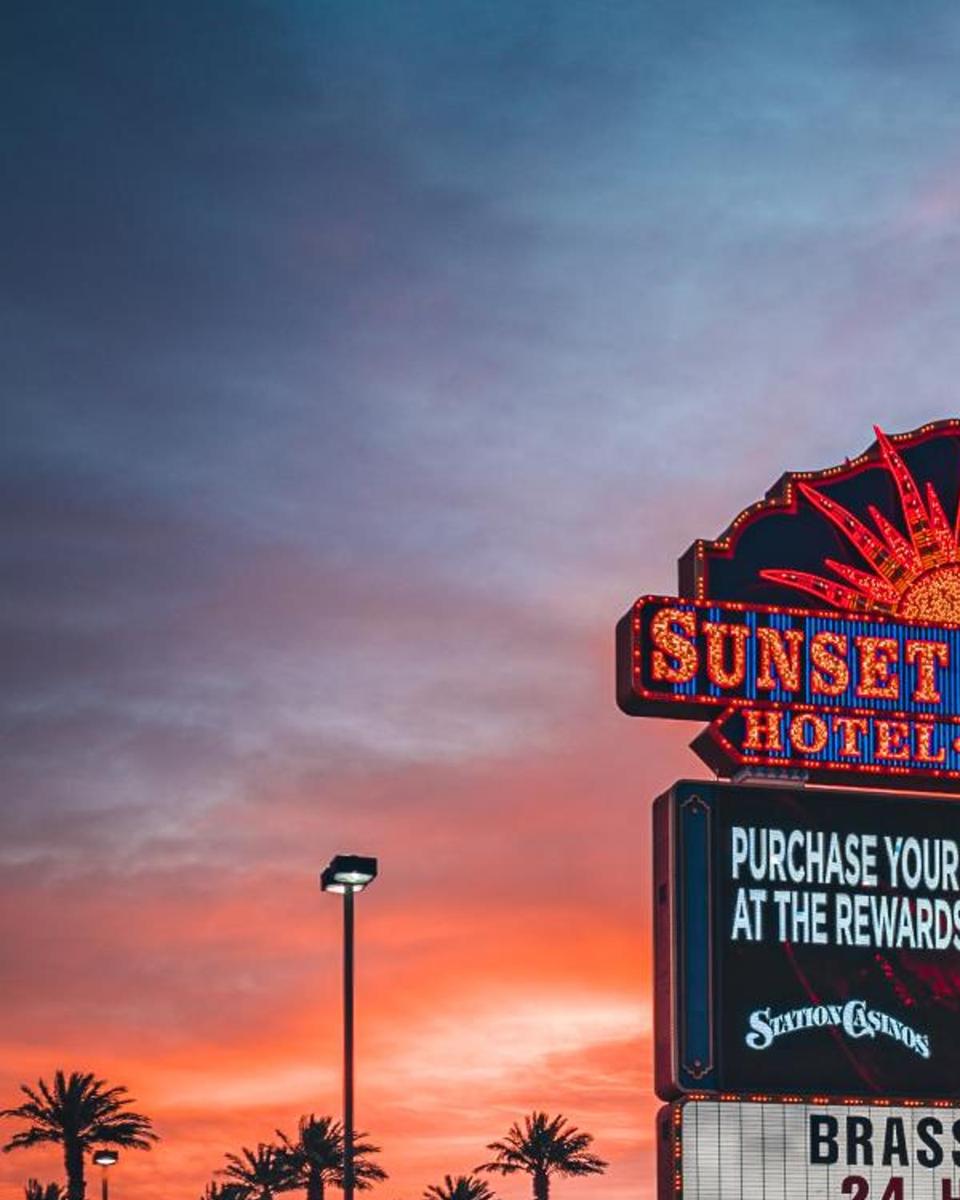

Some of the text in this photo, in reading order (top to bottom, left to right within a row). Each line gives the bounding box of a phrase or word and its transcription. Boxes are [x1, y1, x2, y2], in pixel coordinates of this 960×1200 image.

[650, 607, 949, 704] SUNSET
[741, 710, 946, 763] HOTEL
[731, 826, 878, 887] PURCHASE
[884, 835, 960, 892] YOUR
[731, 887, 768, 942] AT
[774, 890, 828, 945] THE
[745, 999, 932, 1060] STATION CASINOS
